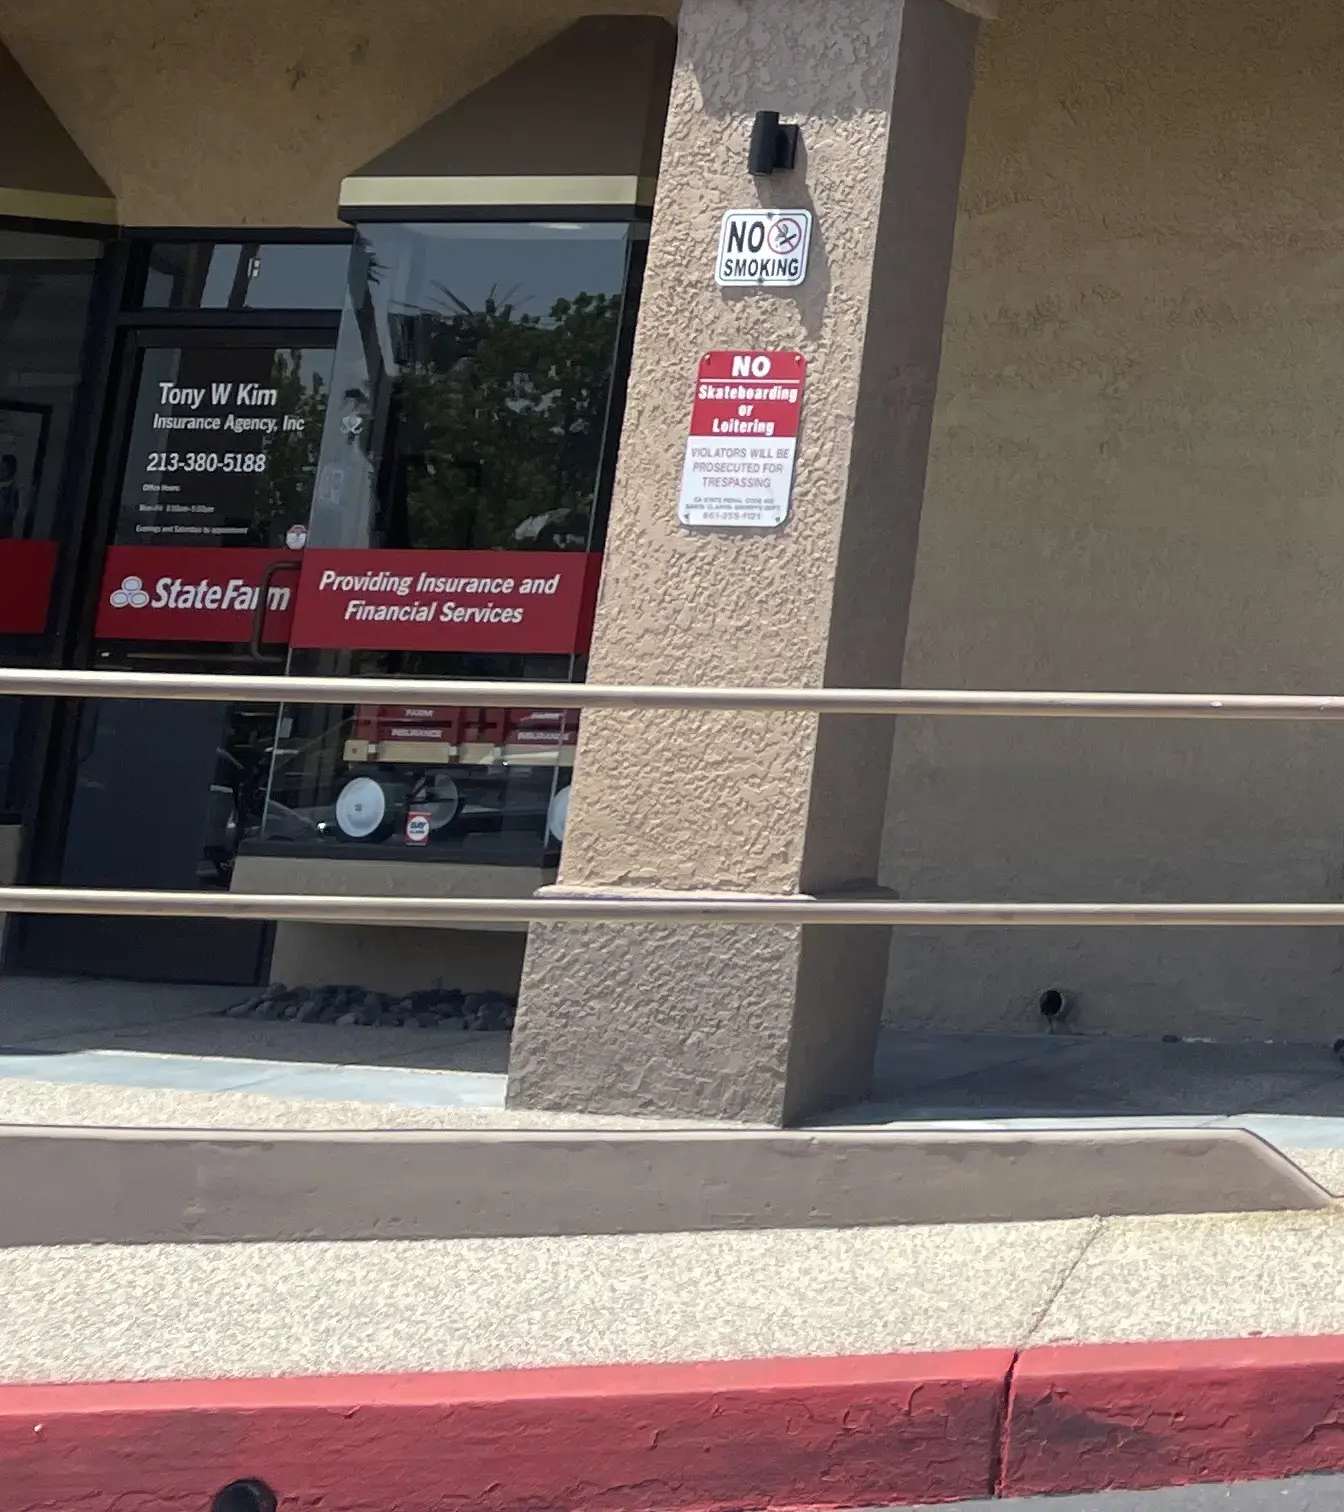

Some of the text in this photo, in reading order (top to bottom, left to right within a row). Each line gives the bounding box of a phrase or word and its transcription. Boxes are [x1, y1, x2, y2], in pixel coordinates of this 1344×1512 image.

[727, 221, 766, 253] NO
[723, 258, 799, 277] SMOKING
[731, 355, 771, 377] NO
[159, 382, 278, 410] Tony W Kim
[698, 384, 799, 403] Skateboarding
[738, 404, 756, 417] or
[153, 413, 306, 433] Insurance Agency, Inc
[712, 417, 775, 436] Loitering
[147, 453, 267, 473] 213-380-5188
[691, 448, 790, 459] VIOLATORS WILL BE
[692, 462, 785, 474] PROSECUTED FOR
[702, 477, 772, 488] TRESPASSING
[318, 570, 561, 595] Providing Insurance and
[344, 600, 525, 624] Financial Services
